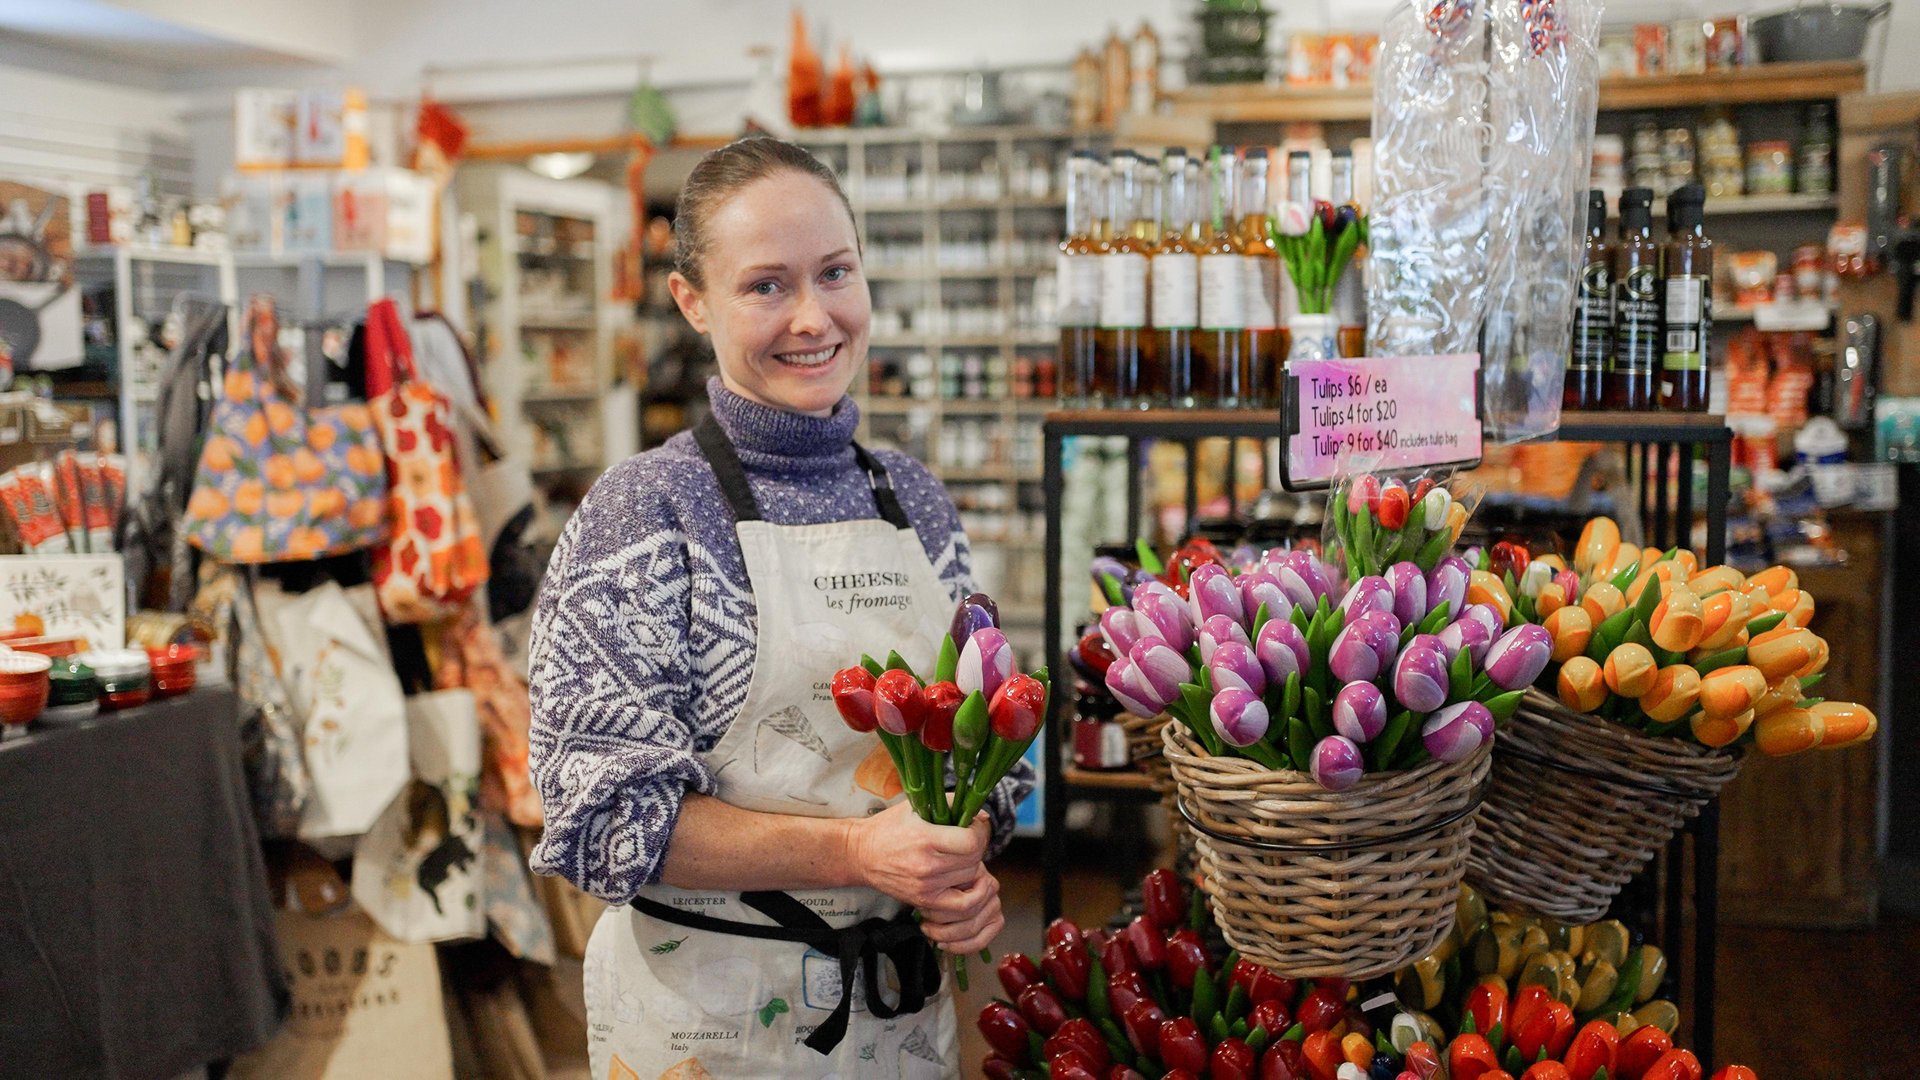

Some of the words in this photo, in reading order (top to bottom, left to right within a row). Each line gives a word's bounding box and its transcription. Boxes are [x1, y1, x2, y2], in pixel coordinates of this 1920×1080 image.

[1311, 378, 1343, 402] Tulips
[1347, 375, 1362, 397] $6
[1365, 374, 1372, 395] /
[1374, 378, 1388, 394] ea
[1311, 406, 1344, 431] Tulips
[1346, 403, 1354, 424] 4
[1357, 403, 1373, 424] for
[1376, 399, 1397, 421] $20
[1347, 433, 1355, 453] 9
[1357, 432, 1374, 452] for
[1377, 429, 1398, 451] $40
[1400, 435, 1428, 448] includes
[1429, 434, 1444, 448] tulip
[1445, 433, 1458, 448] bag
[813, 572, 910, 591] CHEESES
[825, 595, 843, 610] les
[812, 681, 832, 690] CAM
[673, 897, 727, 906] LEICESTER
[799, 898, 835, 907] GOUDA
[795, 1024, 818, 1035] ROQ
[670, 1030, 739, 1041] MOZZARELLA
[670, 1043, 689, 1054] Italy
